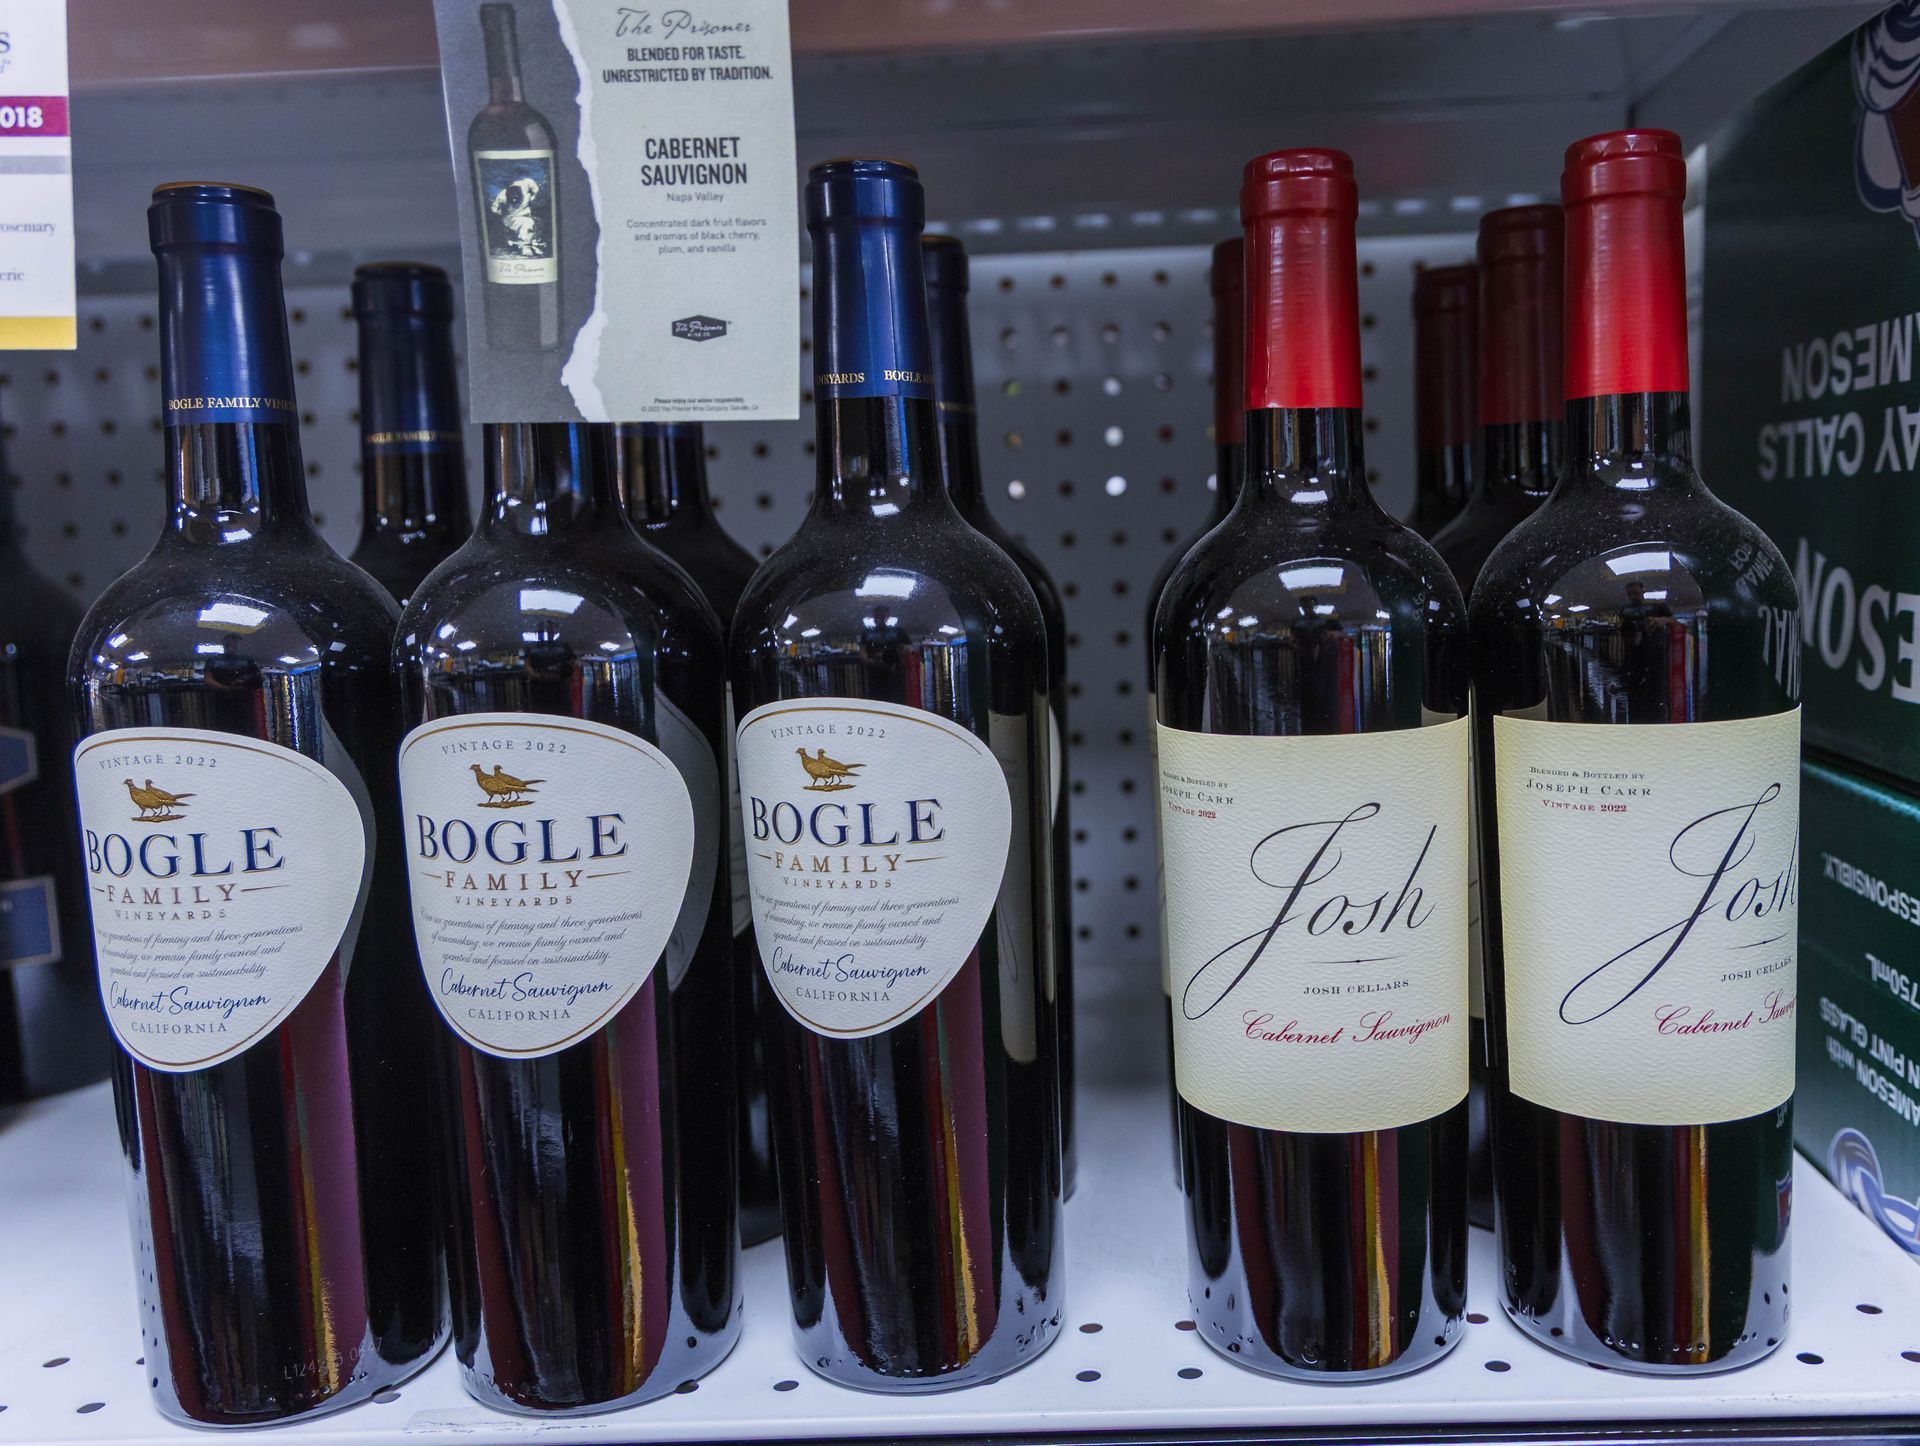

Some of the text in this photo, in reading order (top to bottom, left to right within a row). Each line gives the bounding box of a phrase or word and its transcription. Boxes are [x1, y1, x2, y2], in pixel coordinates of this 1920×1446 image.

[615, 7, 752, 40] The Prisoner
[627, 45, 745, 62] BLENDED FOR TASTE.
[602, 66, 773, 83] UNRESTRICTED BY TRADITION.
[0, 105, 43, 128] 018
[645, 136, 740, 160] CABERNET
[641, 162, 747, 186] SAUVIGNON
[666, 191, 724, 204] Napa Valley
[0, 222, 56, 237] osemary
[626, 217, 767, 229] Concentrated dark fruit flavors
[634, 231, 760, 242] and aromas of black cherry,
[658, 243, 736, 256] plum, and vanilla
[1781, 312, 1920, 403] MESON
[883, 370, 922, 384] BOGLE
[168, 397, 261, 410] BOGLE FAMILY
[1759, 411, 1865, 482] CALLS
[771, 724, 886, 739] VINTAGE 2022
[442, 740, 568, 755] VINTAGE 2022
[100, 755, 217, 770] VINTAGE 2022
[1526, 779, 1651, 796] JOSEPH CARR
[1197, 791, 1234, 805] CARR
[1542, 799, 1628, 812] VINTAGE 2022
[1168, 801, 1217, 819] VINTAGE 2022
[750, 797, 946, 848] BOGLE
[416, 812, 629, 865] BOGLE
[85, 826, 286, 878] BOGLE
[774, 851, 902, 873] FAMILY
[445, 869, 584, 891] FAMILY
[783, 876, 892, 889] VINEYARDS
[107, 883, 238, 904] FAMILY
[455, 895, 573, 907] VINEYARDS
[115, 908, 226, 921] VINEYARDS
[858, 899, 880, 912] and
[880, 899, 904, 911] three
[902, 896, 960, 915] generations
[1183, 802, 1438, 1021] Josh
[537, 916, 560, 929] and
[560, 913, 585, 928] three
[583, 910, 642, 931] generations
[852, 918, 886, 935] family
[888, 915, 922, 928] owned
[922, 912, 944, 926] and
[191, 929, 214, 943] and
[238, 924, 303, 944] generations
[497, 940, 531, 948] remain
[529, 935, 566, 952] family
[568, 931, 605, 944] owned
[604, 927, 627, 940] and
[813, 935, 850, 950] focused
[223, 944, 262, 958] owned
[261, 941, 286, 955] and
[487, 954, 528, 969] focused
[772, 947, 930, 989] Cabernet Sauvignon
[1720, 956, 1792, 982] JOSH CELLARS
[440, 967, 613, 1005] Cabernet Sauvignon
[1303, 979, 1409, 995] JOSH CELLARS
[1865, 952, 1920, 1010] 750mL
[110, 981, 270, 1020] Cabernet Sauvignon
[796, 986, 890, 1001] CALIFORNIA
[468, 1008, 571, 1021] CALIFORNIA
[1654, 1004, 1753, 1036] Cabernet
[1820, 996, 1868, 1048] GLASS
[131, 1021, 227, 1034] CALIFORNIA
[1242, 1009, 1451, 1044] Cabernet Sauvignon
[1825, 1035, 1855, 1070] with
[1869, 1033, 1905, 1078] PINT
